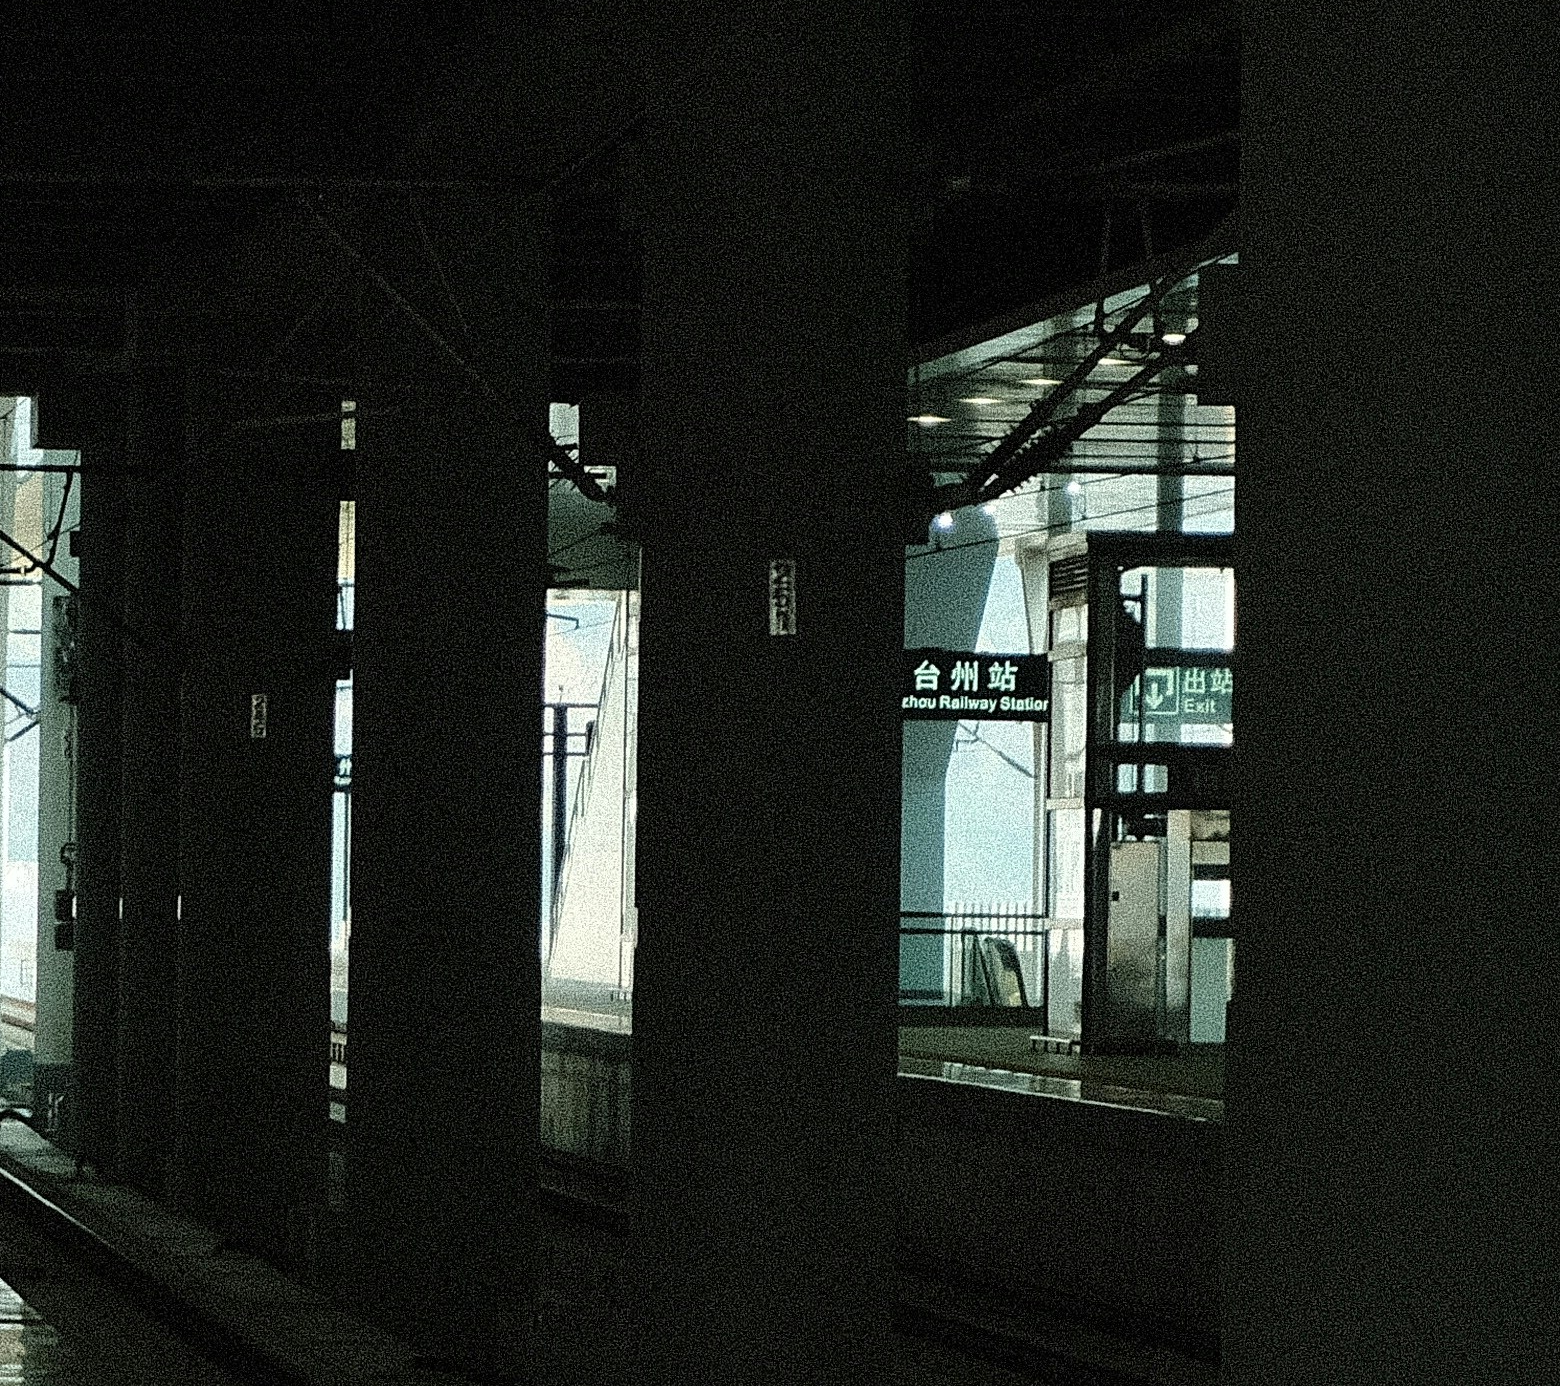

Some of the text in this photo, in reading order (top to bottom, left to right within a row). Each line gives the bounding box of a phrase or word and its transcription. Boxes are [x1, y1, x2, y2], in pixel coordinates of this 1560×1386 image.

[912, 658, 1020, 693] 台州站
[939, 695, 998, 713] Railway
[1183, 698, 1217, 714] Exit
